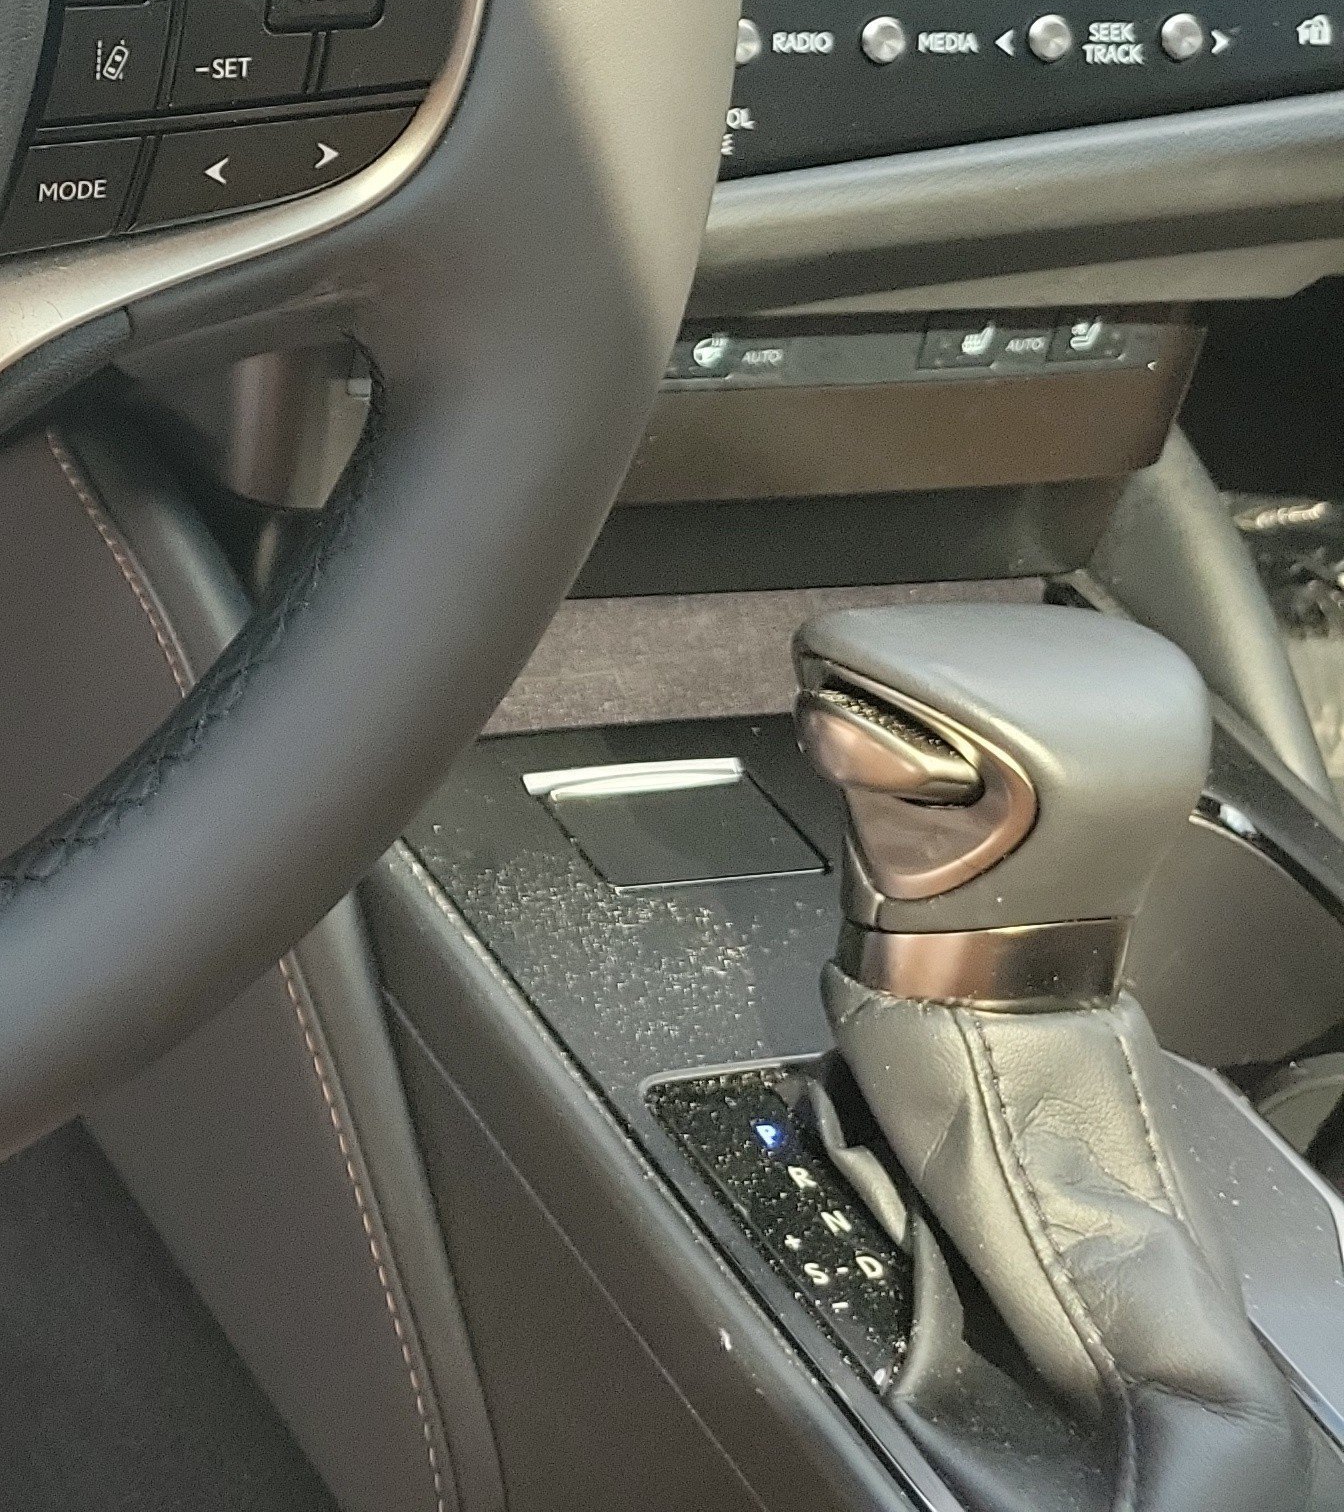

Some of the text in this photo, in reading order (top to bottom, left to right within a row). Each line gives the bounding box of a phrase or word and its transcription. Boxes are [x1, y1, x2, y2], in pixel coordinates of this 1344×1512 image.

[772, 31, 835, 54] RADIO
[917, 32, 980, 54] MEDIA
[1089, 21, 1135, 43] SEEK
[1082, 43, 1145, 65] TRACK
[726, 107, 755, 130] OL
[38, 179, 108, 203] MODE
[742, 348, 784, 365] AUTO
[1005, 337, 1048, 353] AUTO
[755, 1123, 778, 1150] P
[787, 1165, 818, 1189] R
[821, 1210, 853, 1234] N
[803, 1255, 884, 1286] S D
